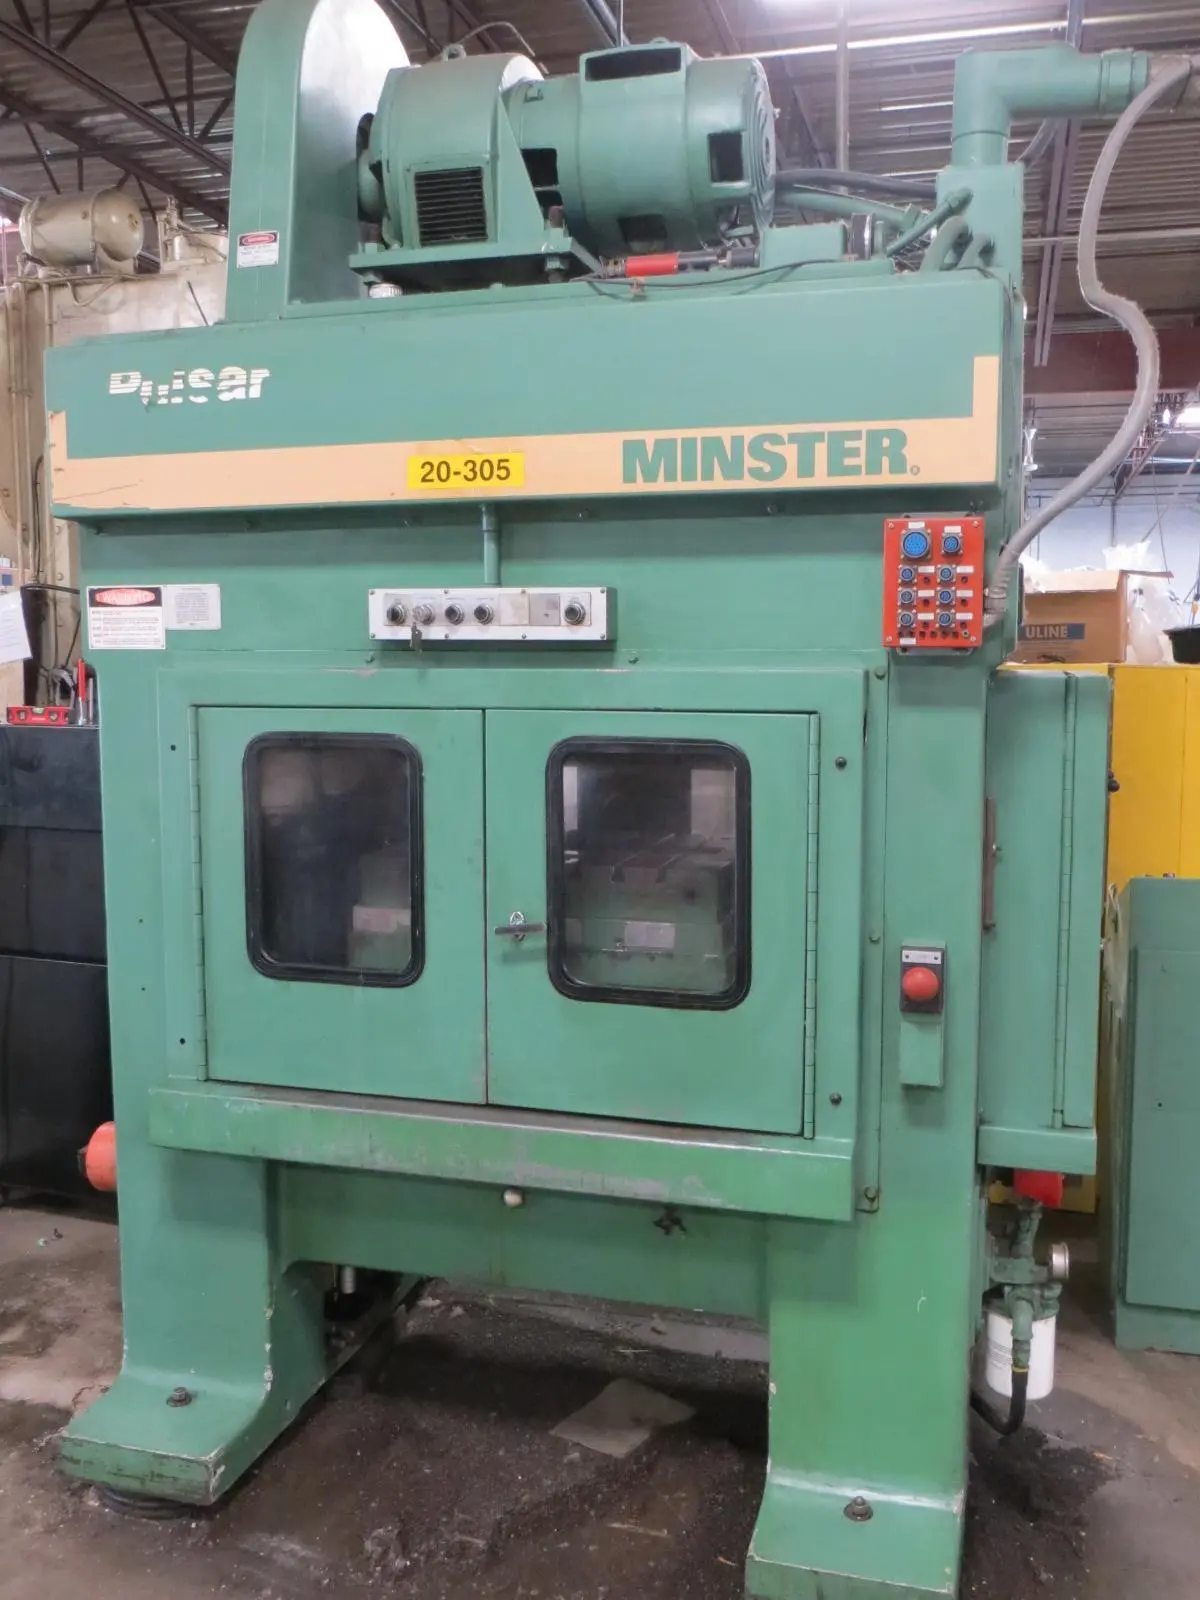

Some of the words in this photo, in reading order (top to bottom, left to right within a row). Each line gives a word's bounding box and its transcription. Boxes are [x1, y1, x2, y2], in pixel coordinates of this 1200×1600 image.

[622, 428, 908, 484] MINSTER
[420, 458, 511, 483] 20-305
[1025, 625, 1068, 639] ULINE
